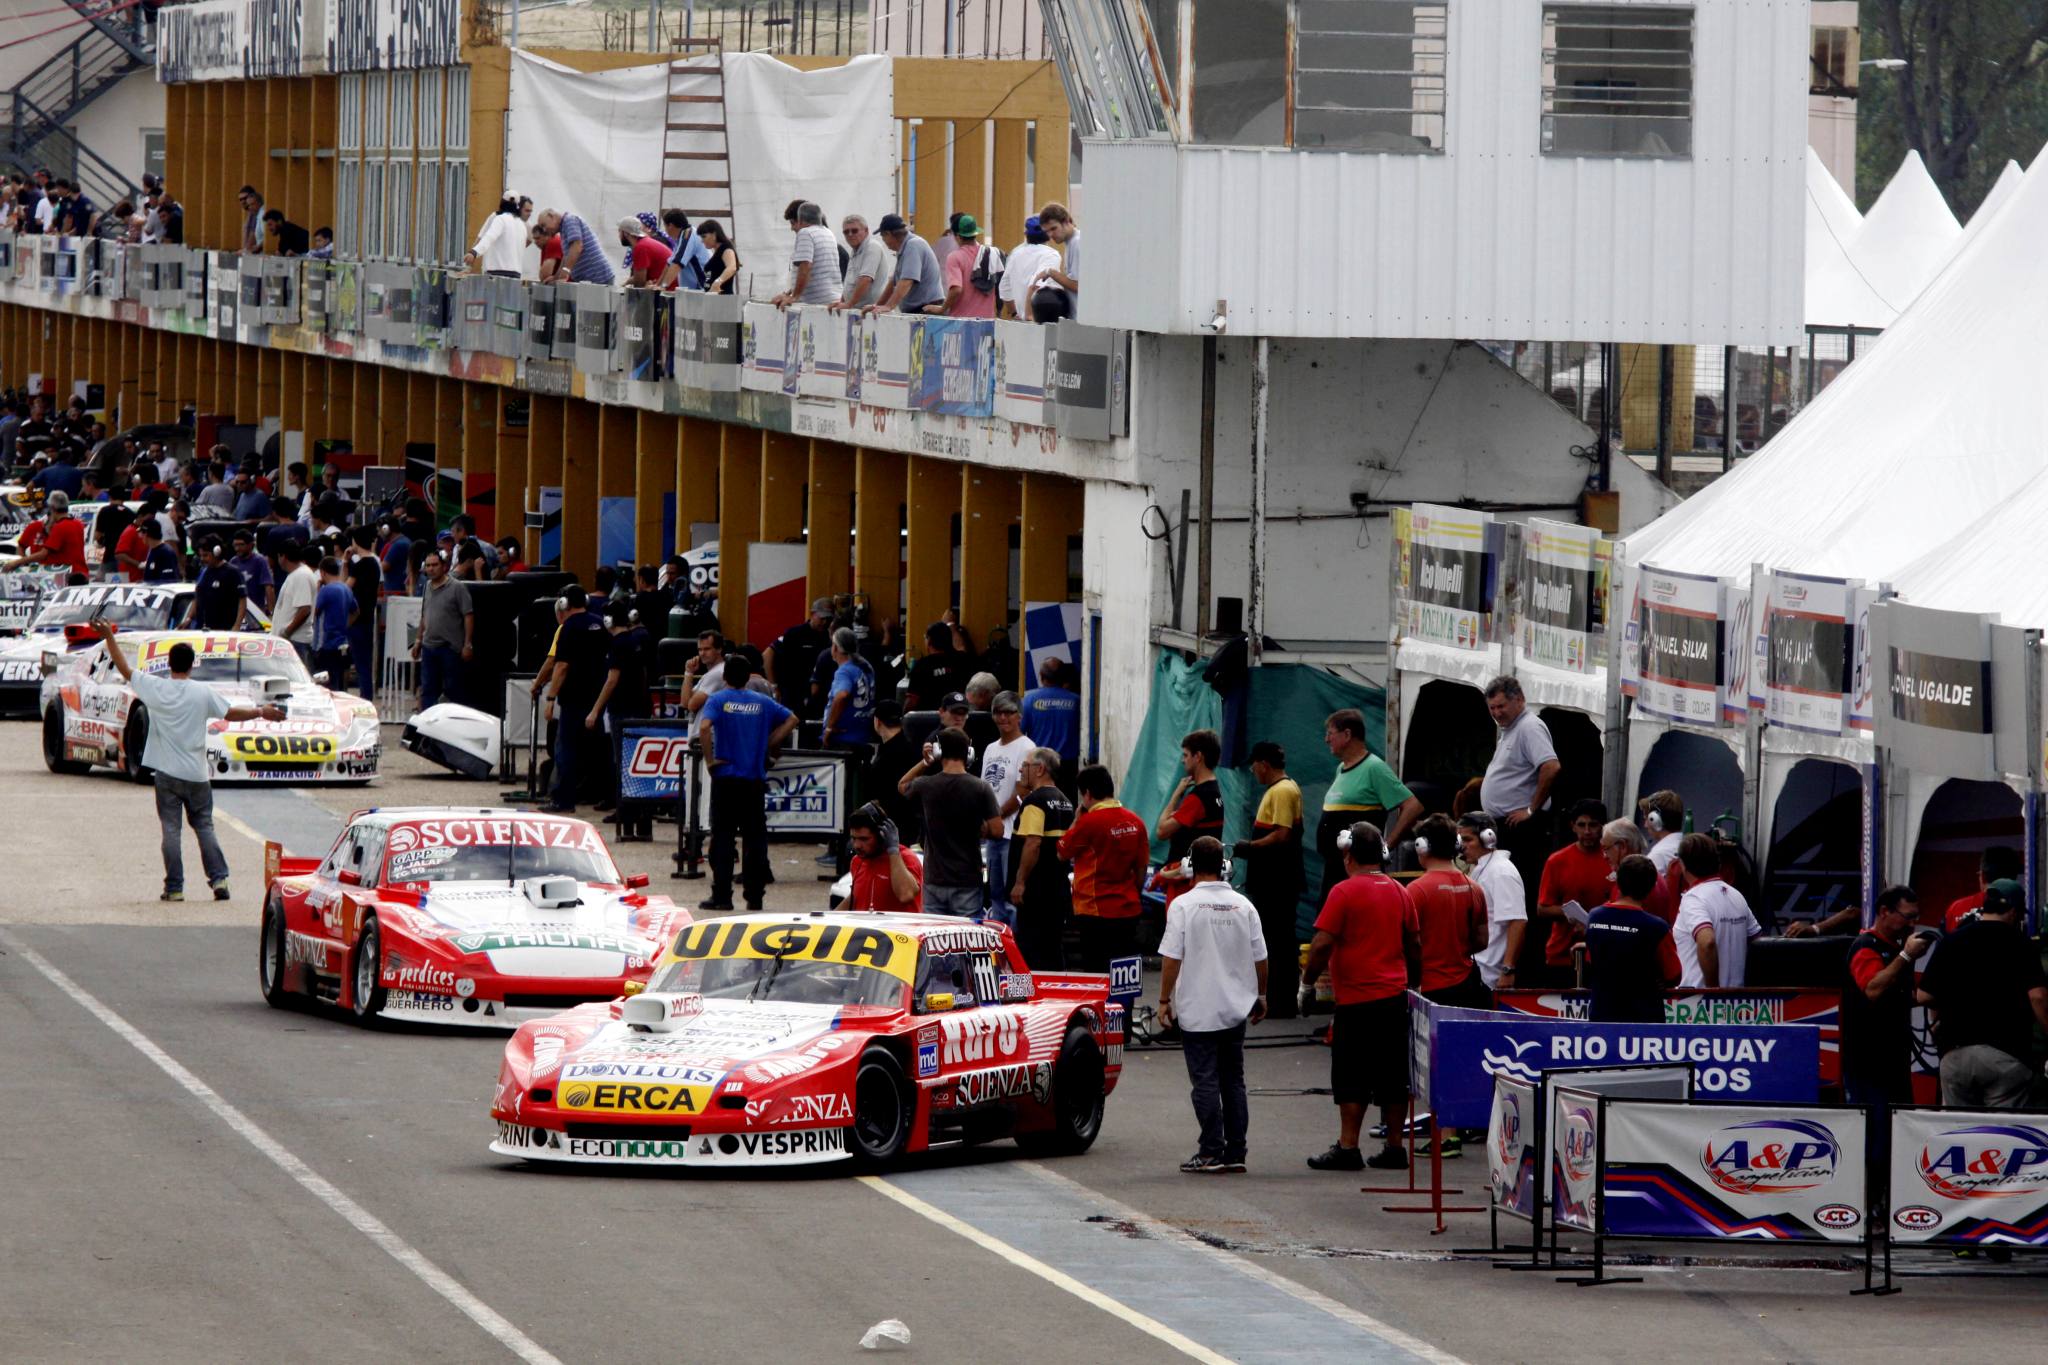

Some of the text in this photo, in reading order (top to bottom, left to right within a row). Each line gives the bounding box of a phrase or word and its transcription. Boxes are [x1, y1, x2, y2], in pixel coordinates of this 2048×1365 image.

[1681, 639, 1708, 661] SILVA
[1919, 680, 1972, 706] UGALDE
[236, 736, 331, 755] COIRO
[764, 774, 819, 797] QUA
[419, 820, 606, 858] SCIENZA
[400, 960, 455, 986] perdices
[1112, 960, 1140, 987] md
[386, 1000, 454, 1011] GUERRERO
[387, 990, 412, 999] ELOY
[919, 1050, 938, 1069] md
[1551, 1036, 1777, 1063] RIO URUGUAY
[633, 1065, 716, 1082] LUIS
[955, 1064, 1032, 1106] SCIENZA
[594, 1085, 695, 1112] ERCA
[741, 1127, 843, 1155] VESPRINI
[1710, 1140, 1832, 1170] A&P
[1927, 1146, 2048, 1176] A&P
